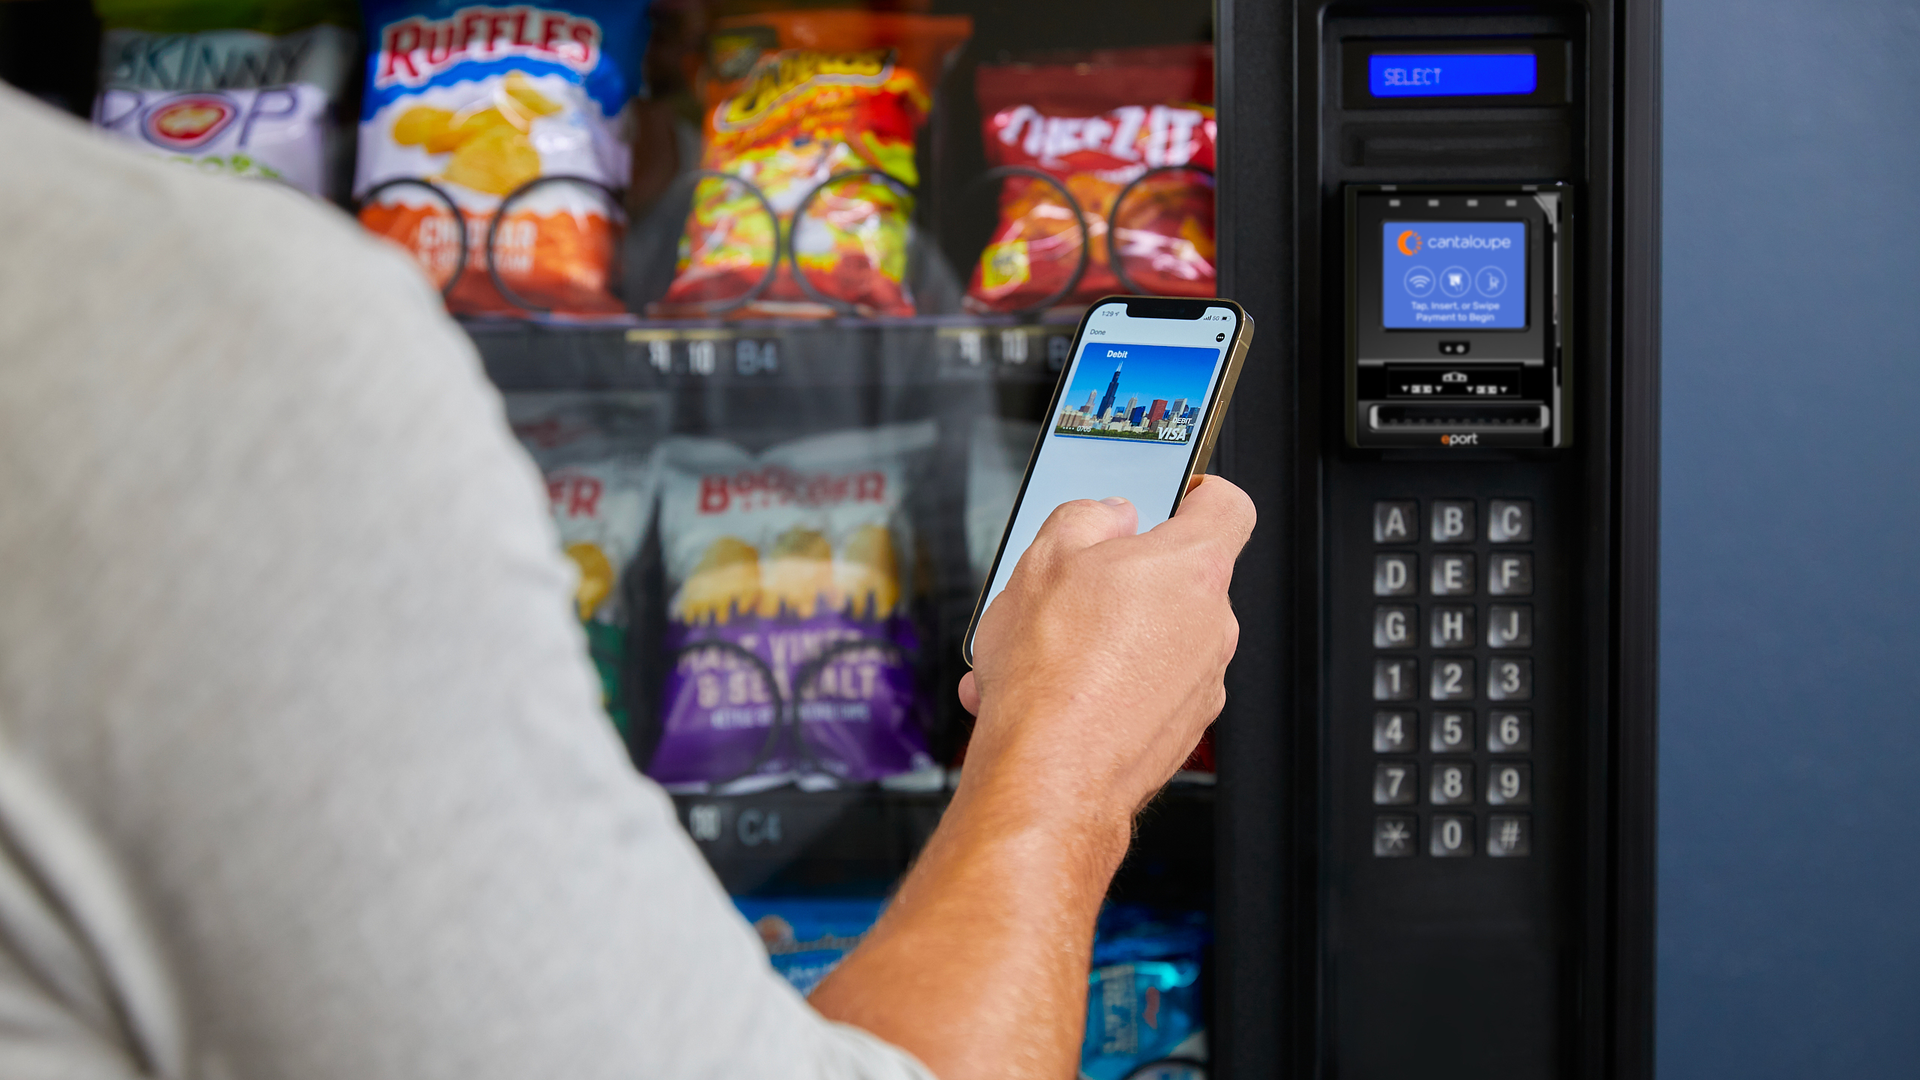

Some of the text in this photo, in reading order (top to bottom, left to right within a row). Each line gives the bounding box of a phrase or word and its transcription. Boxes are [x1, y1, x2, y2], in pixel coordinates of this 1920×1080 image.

[380, 10, 597, 80] RUFFLES
[102, 32, 312, 89] SKINNY
[1384, 68, 1441, 86] SELECT
[1427, 235, 1511, 250] cantaloupe
[1411, 301, 1428, 311] Tap,
[1431, 301, 1459, 311] Insert,
[1473, 301, 1500, 311] Swipe
[1416, 313, 1495, 323] Payment to Begin
[1107, 350, 1128, 358] Debit
[1157, 427, 1187, 440] VISA
[1441, 433, 1478, 447] eport
[1385, 507, 1406, 537] A
[1444, 506, 1463, 536] B
[1502, 506, 1521, 536] C
[1386, 560, 1406, 589] D
[1444, 559, 1462, 589] E
[1502, 559, 1520, 589] F
[1385, 611, 1406, 642] G
[1443, 612, 1463, 641] H
[1502, 611, 1519, 641] J
[1388, 664, 1400, 693] 1
[1444, 663, 1462, 693] 2
[1502, 663, 1520, 692] 3
[1385, 715, 1404, 745] 4
[1444, 715, 1462, 745] 5
[1501, 715, 1519, 745] 6
[1387, 769, 1405, 798] 7
[1444, 768, 1462, 798] 8
[1501, 768, 1519, 798] 9
[738, 808, 781, 846] C4
[1500, 820, 1520, 849] #
